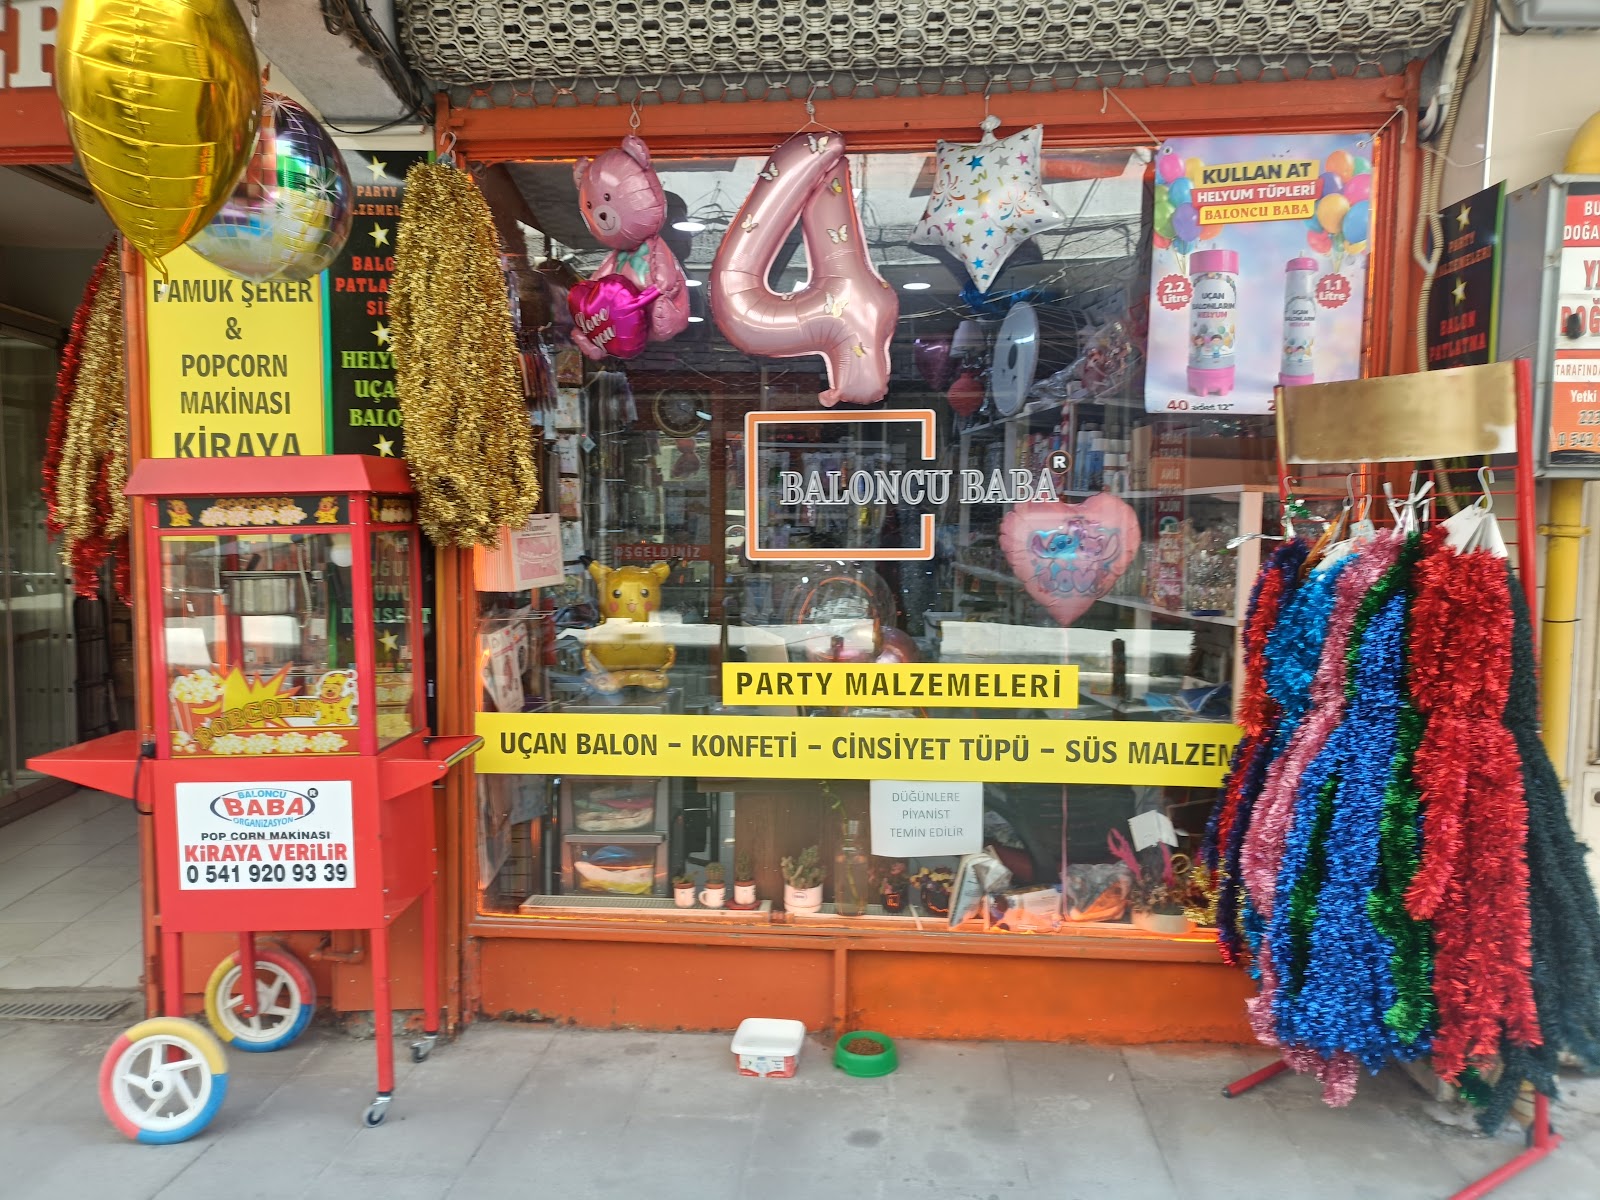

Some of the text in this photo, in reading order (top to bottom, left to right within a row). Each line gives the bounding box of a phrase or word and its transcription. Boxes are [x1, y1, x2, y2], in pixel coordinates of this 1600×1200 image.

[1203, 162, 1312, 184] KULLAN AT
[356, 185, 398, 198] PARTY
[1197, 182, 1316, 203] HELYUM TÜPLERİ
[1204, 204, 1310, 221] BALONCU BABA
[1563, 221, 1600, 240] DOĞA
[352, 256, 395, 271] BALO
[241, 280, 314, 308] ŞEKER
[335, 277, 392, 293] PATLA
[1164, 282, 1185, 293] 2.2
[1323, 280, 1342, 291] 1.1
[1162, 294, 1188, 304] Litre
[1318, 291, 1346, 300] Litre
[1561, 298, 1600, 336] DOĞ
[225, 316, 243, 340] &
[181, 354, 288, 377] POPCORN
[180, 386, 291, 414] MAKİNASI
[354, 379, 397, 403] UÇA
[1570, 389, 1597, 402] Yetki
[1167, 400, 1188, 410] 40
[1267, 400, 1277, 411] 2
[349, 408, 402, 427] BALO
[174, 425, 301, 458] KİRAYA
[780, 468, 1059, 505] BALONCU BABA
[736, 669, 1061, 698] PARTY MALZEMELERİ
[500, 732, 566, 759] UÇAN
[576, 733, 658, 755] BALON
[692, 731, 797, 758] KONFETİ
[832, 732, 950, 760] CİNSİYET
[959, 735, 1029, 762] TÜPÜ
[1065, 736, 1117, 763] SÜS
[1128, 741, 1237, 766] MALZEM
[237, 790, 287, 799] BALONCU
[892, 790, 960, 802] DÜĞÜNLERE
[222, 797, 304, 816] BABA
[902, 808, 950, 819] PİYANİST
[201, 829, 331, 841] POP CORN MAKİNASI
[890, 825, 963, 838] TEMİN EDİLİR
[186, 863, 347, 883] 0 541 920 93 39
